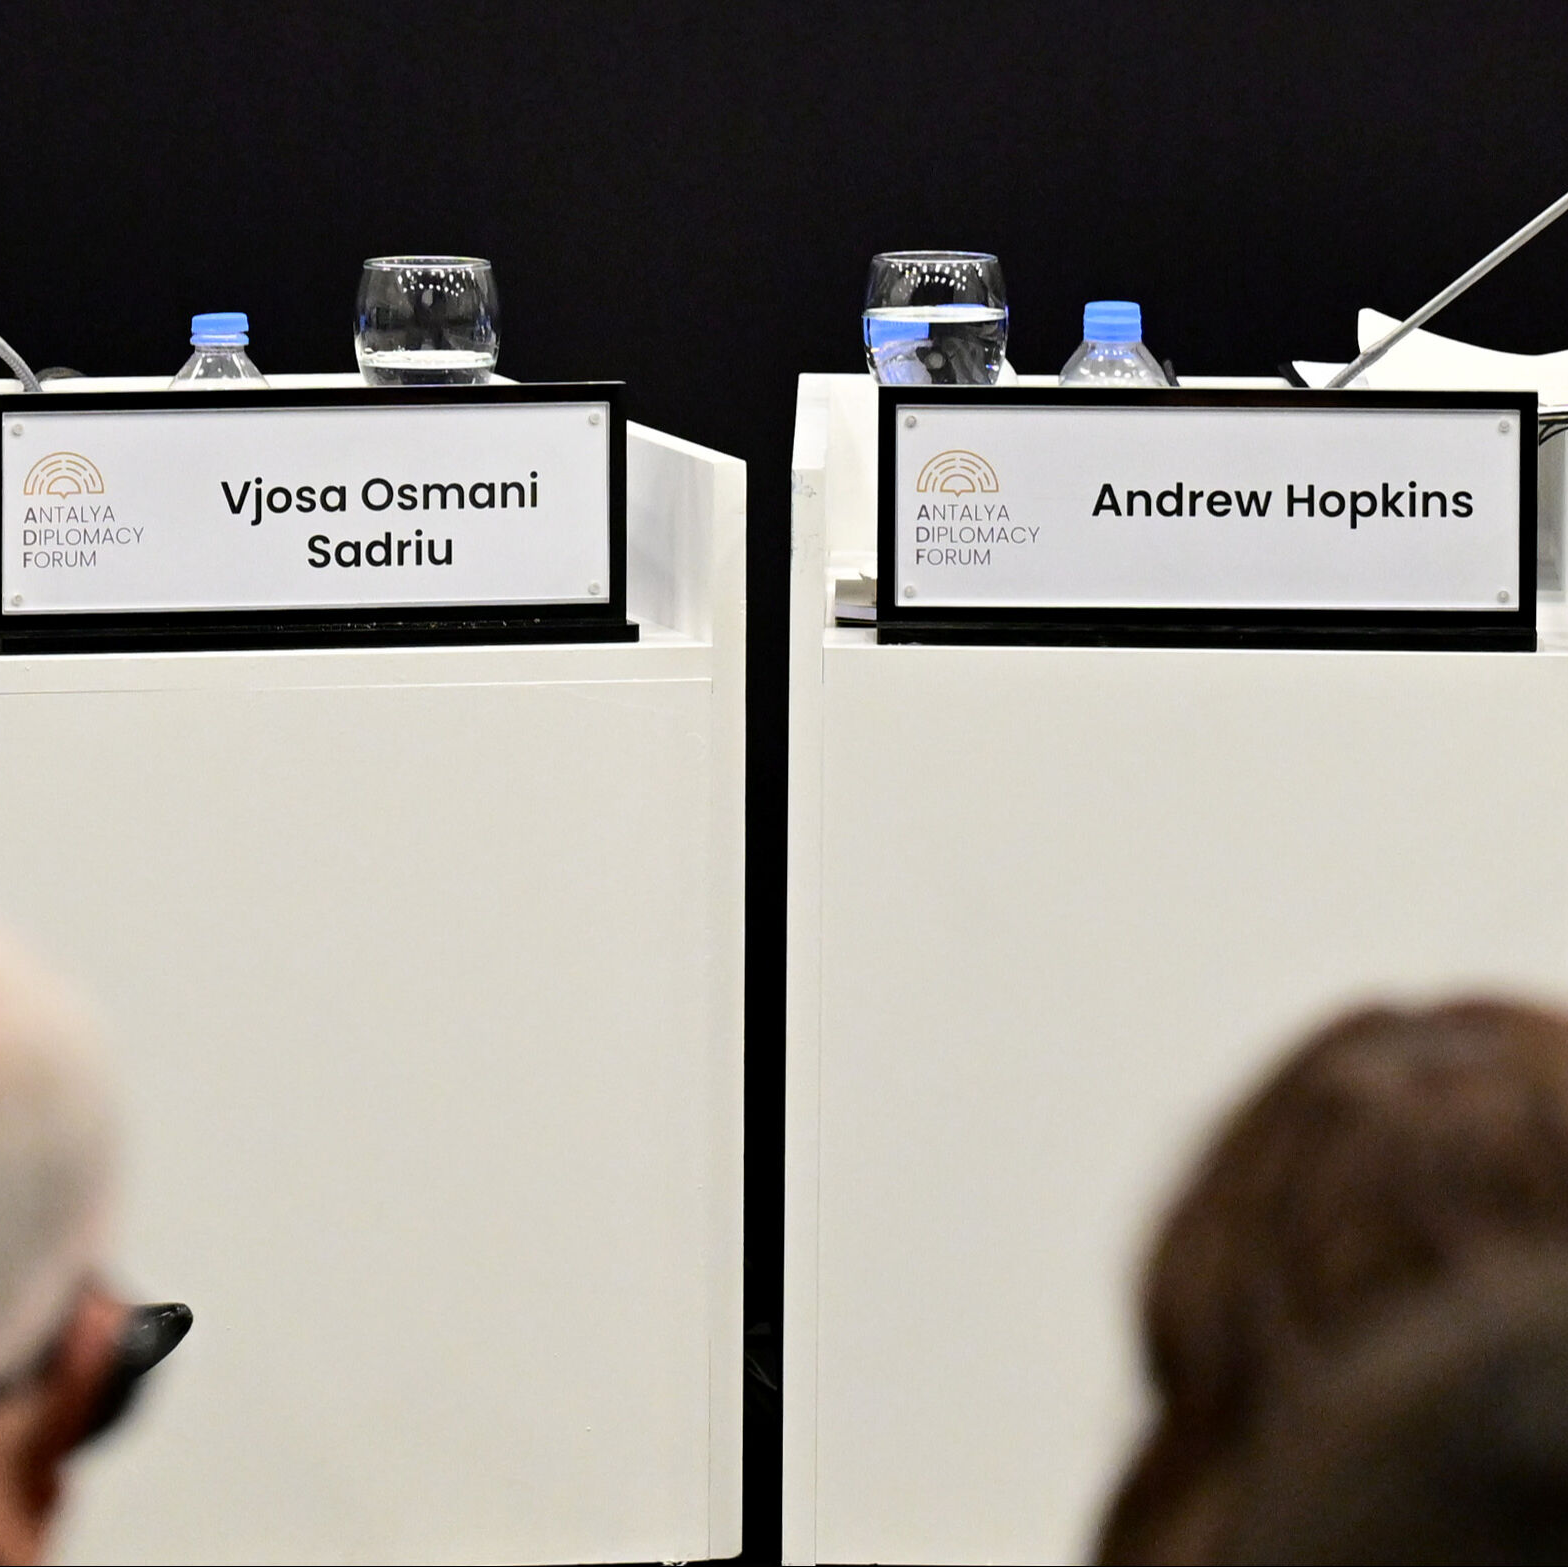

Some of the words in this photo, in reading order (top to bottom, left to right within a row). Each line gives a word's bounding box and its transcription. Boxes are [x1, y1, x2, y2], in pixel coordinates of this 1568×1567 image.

[220, 476, 347, 527] Vjosa
[361, 470, 539, 512] Osmani
[1092, 481, 1273, 518] Andrew
[1286, 480, 1474, 530] Hopkins
[23, 505, 116, 524] ANTALYA
[916, 503, 1011, 522] ANTALYA
[22, 526, 145, 546] DIPLOMACY
[915, 526, 1041, 544] DIPLOMACY
[307, 528, 454, 569] Sadriu
[915, 547, 991, 566] FORUM
[22, 549, 97, 569] FORUM
